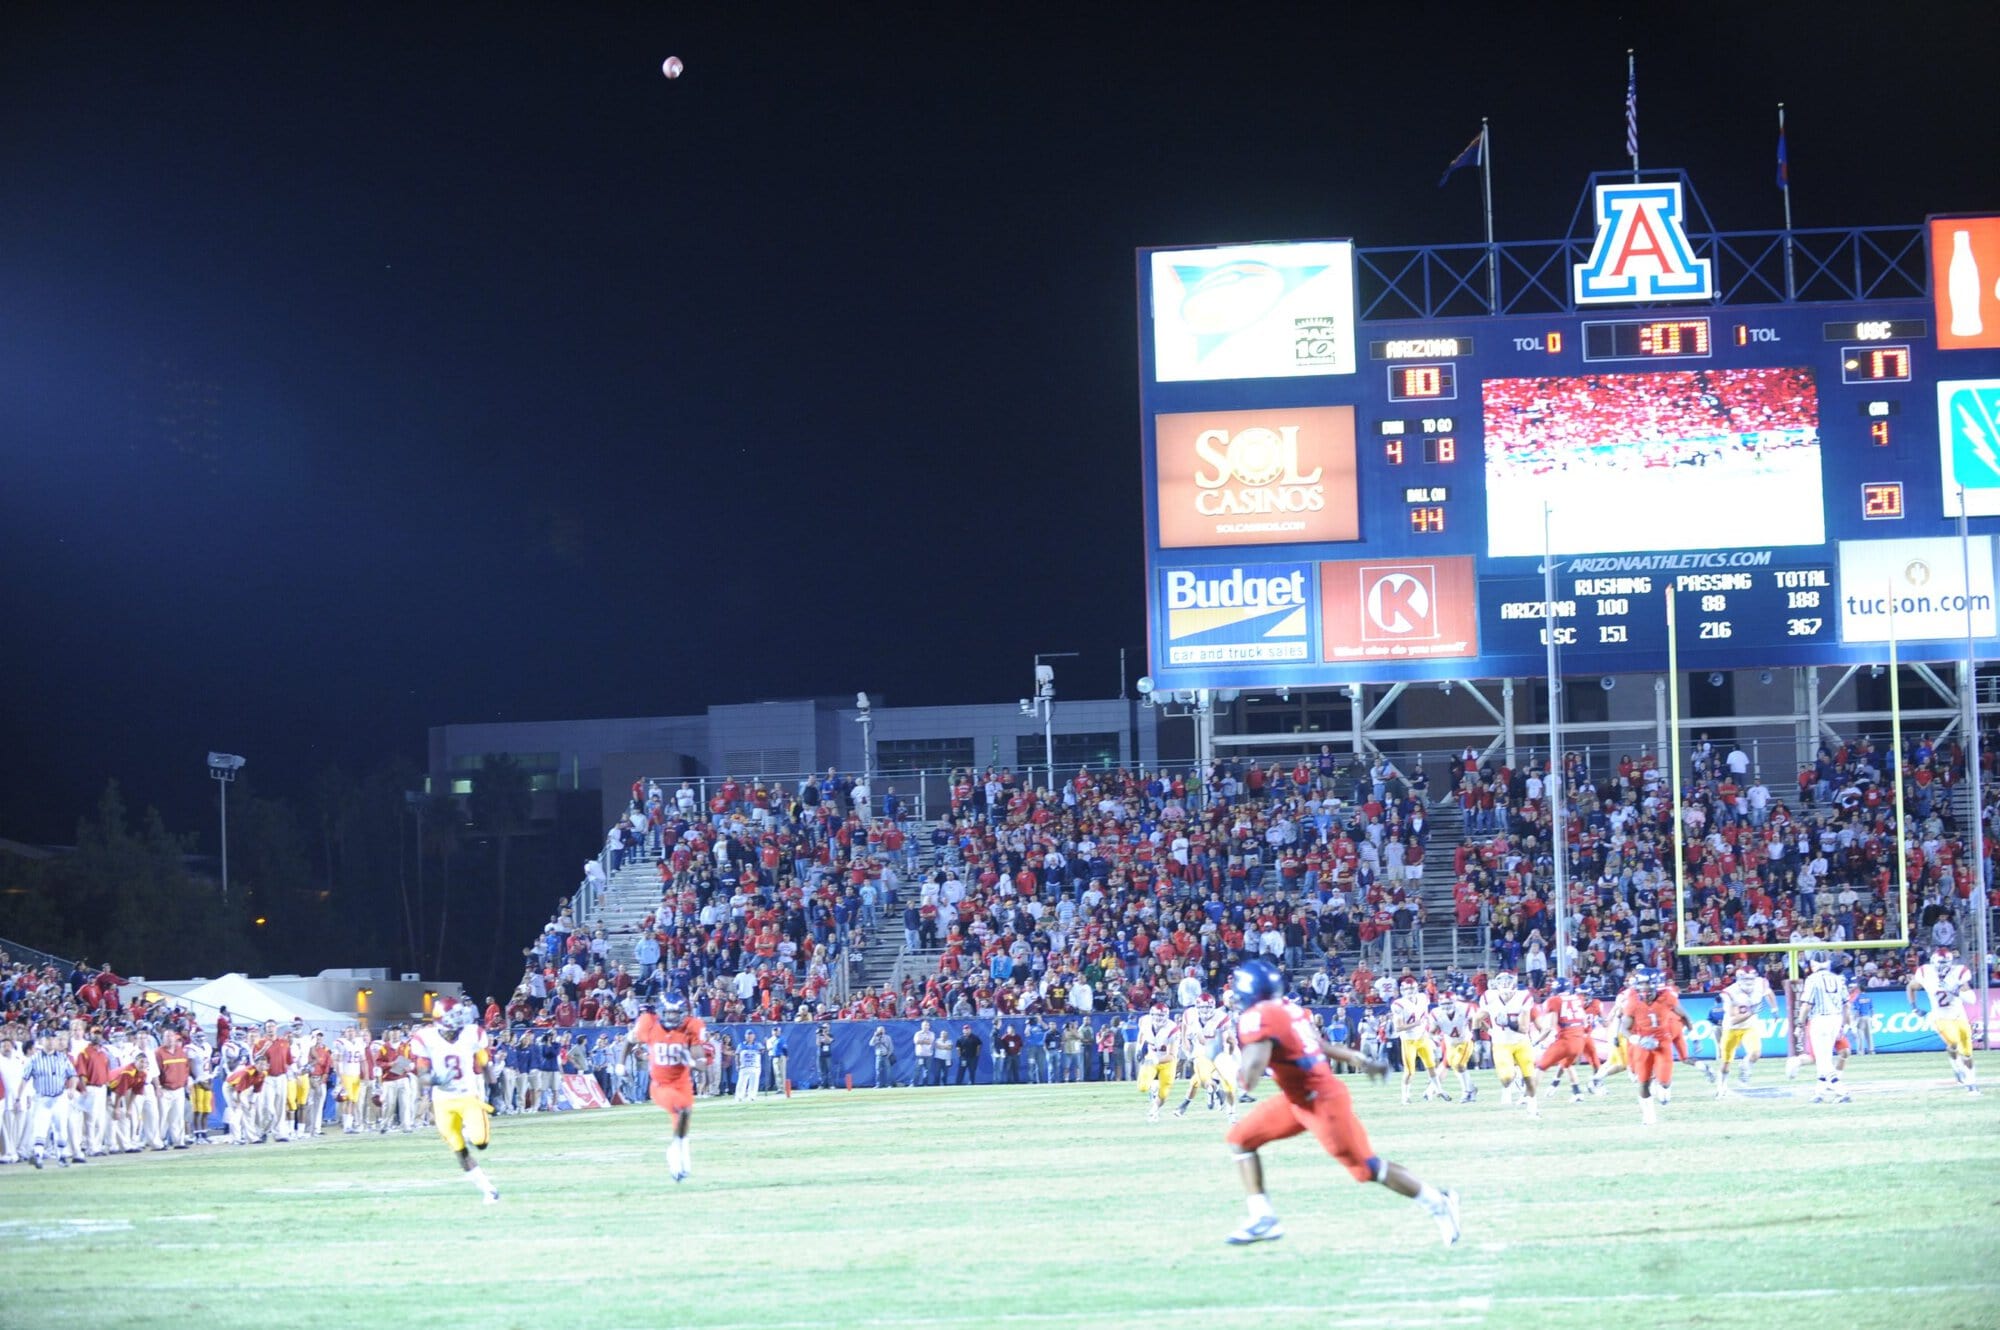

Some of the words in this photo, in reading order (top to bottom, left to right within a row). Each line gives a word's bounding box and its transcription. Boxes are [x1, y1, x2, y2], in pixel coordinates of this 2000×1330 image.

[1574, 182, 1712, 304] A
[1547, 332, 1562, 352] 0
[1750, 327, 1780, 342] TOL
[1857, 322, 1892, 340] USC
[1386, 339, 1458, 358] ARIZONA
[1513, 337, 1544, 351] TOL
[1871, 349, 1909, 379] 17
[1405, 367, 1441, 396] 10
[1422, 419, 1436, 433] TO
[1437, 418, 1452, 433] GO
[1871, 420, 1888, 445] 4
[1194, 426, 1322, 489] SOL
[1386, 440, 1403, 464] 4
[1438, 438, 1455, 462] 8
[1194, 485, 1326, 516] CASINOS
[1406, 488, 1430, 502] BALL
[1430, 487, 1446, 502] ON
[1865, 486, 1900, 515] 20
[1411, 507, 1444, 532] 44
[1568, 551, 1772, 573] ARIZONAATHLETICS.COM
[1167, 568, 1306, 613] Budget
[1575, 577, 1652, 596] RUSHING
[1676, 573, 1752, 592] PASSING
[1774, 570, 1830, 588] TOTAL
[1501, 600, 1577, 619] ARIZONA
[1596, 598, 1628, 616] 100
[1702, 594, 1726, 612] 88
[1787, 591, 1820, 608] 188
[1847, 594, 1990, 615] tucson.com
[1599, 625, 1628, 643] 151
[1700, 621, 1732, 639] 216
[1787, 618, 1822, 636] 367
[1173, 651, 1193, 662] car
[1200, 648, 1224, 660] and
[1228, 646, 1263, 659] truck
[1269, 642, 1304, 657] sales
[849, 953, 864, 962] 26
[1822, 975, 1837, 994] U
[1559, 999, 1585, 1021] 45
[1935, 991, 1950, 1008] 2
[1648, 1013, 1658, 1028] 1
